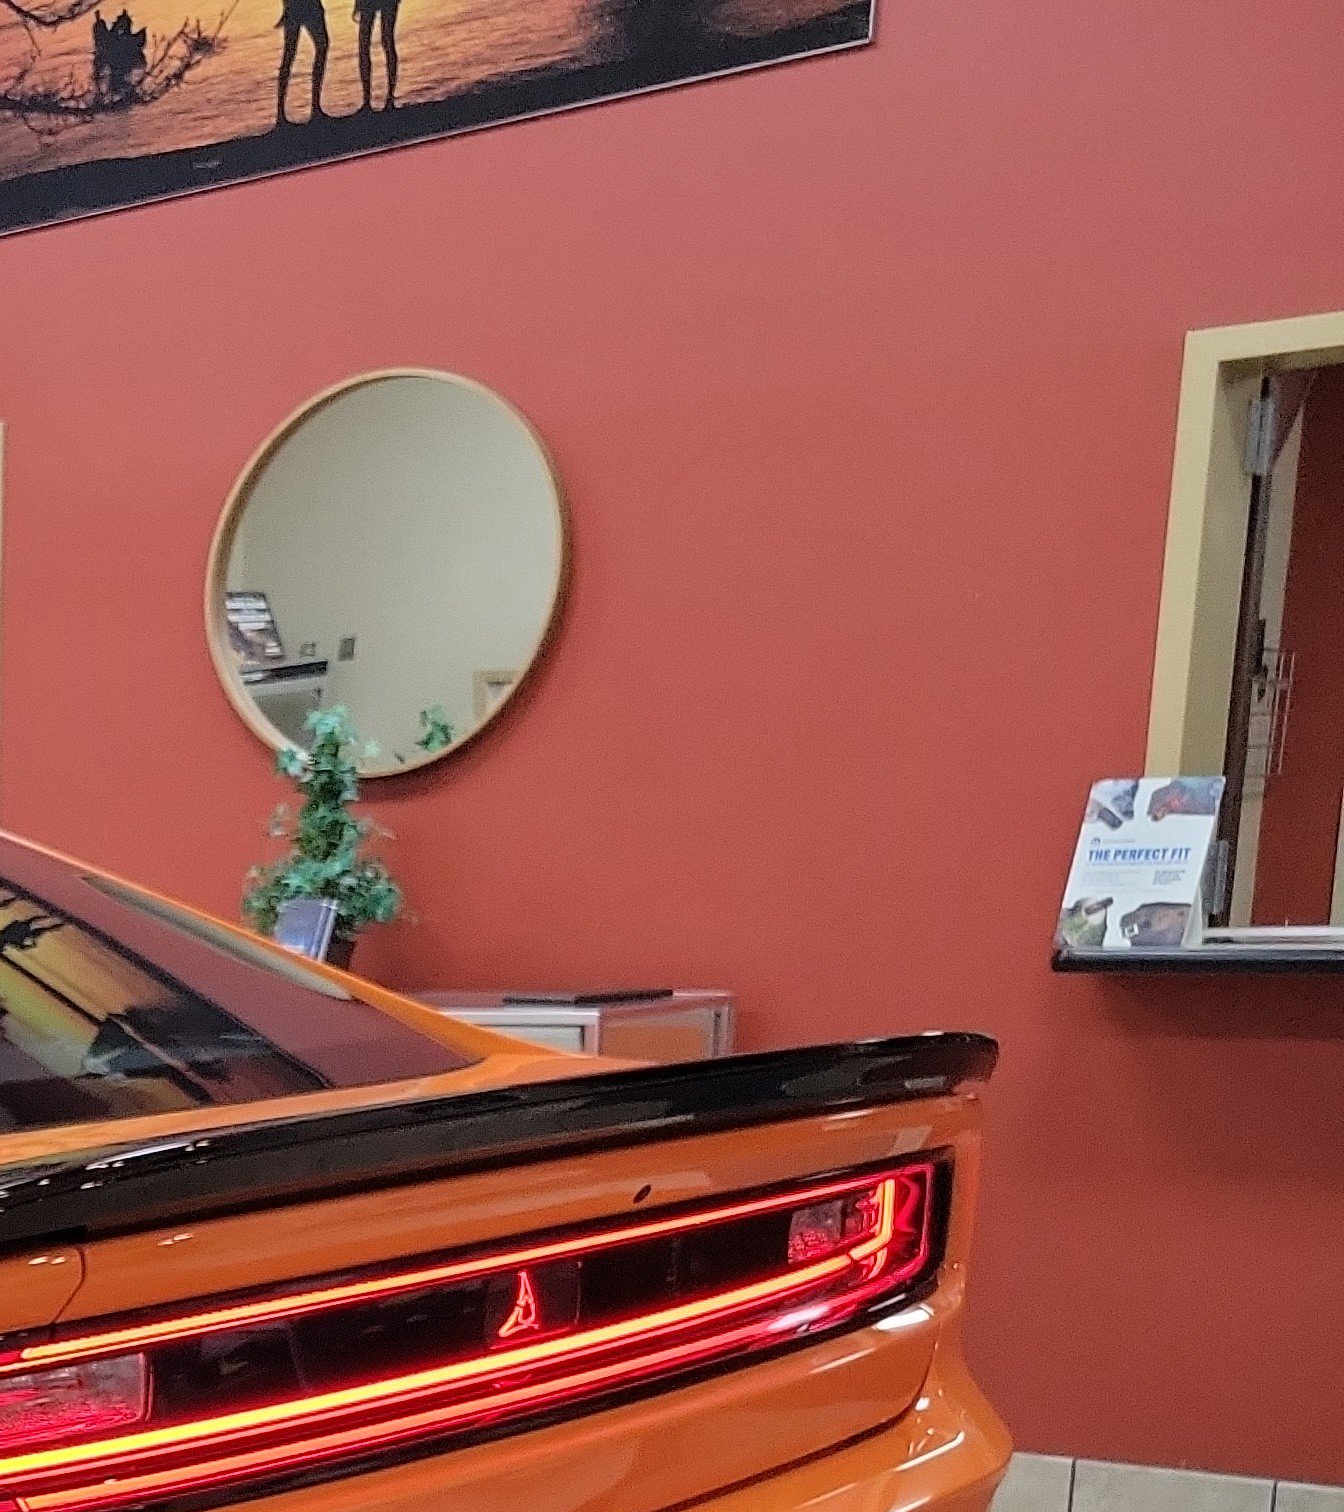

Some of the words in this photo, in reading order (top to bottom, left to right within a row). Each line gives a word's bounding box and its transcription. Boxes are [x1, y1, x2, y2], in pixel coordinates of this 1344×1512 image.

[1088, 849, 1111, 861] THE
[1113, 848, 1169, 860] PERFECT
[1170, 847, 1192, 860] FIT
